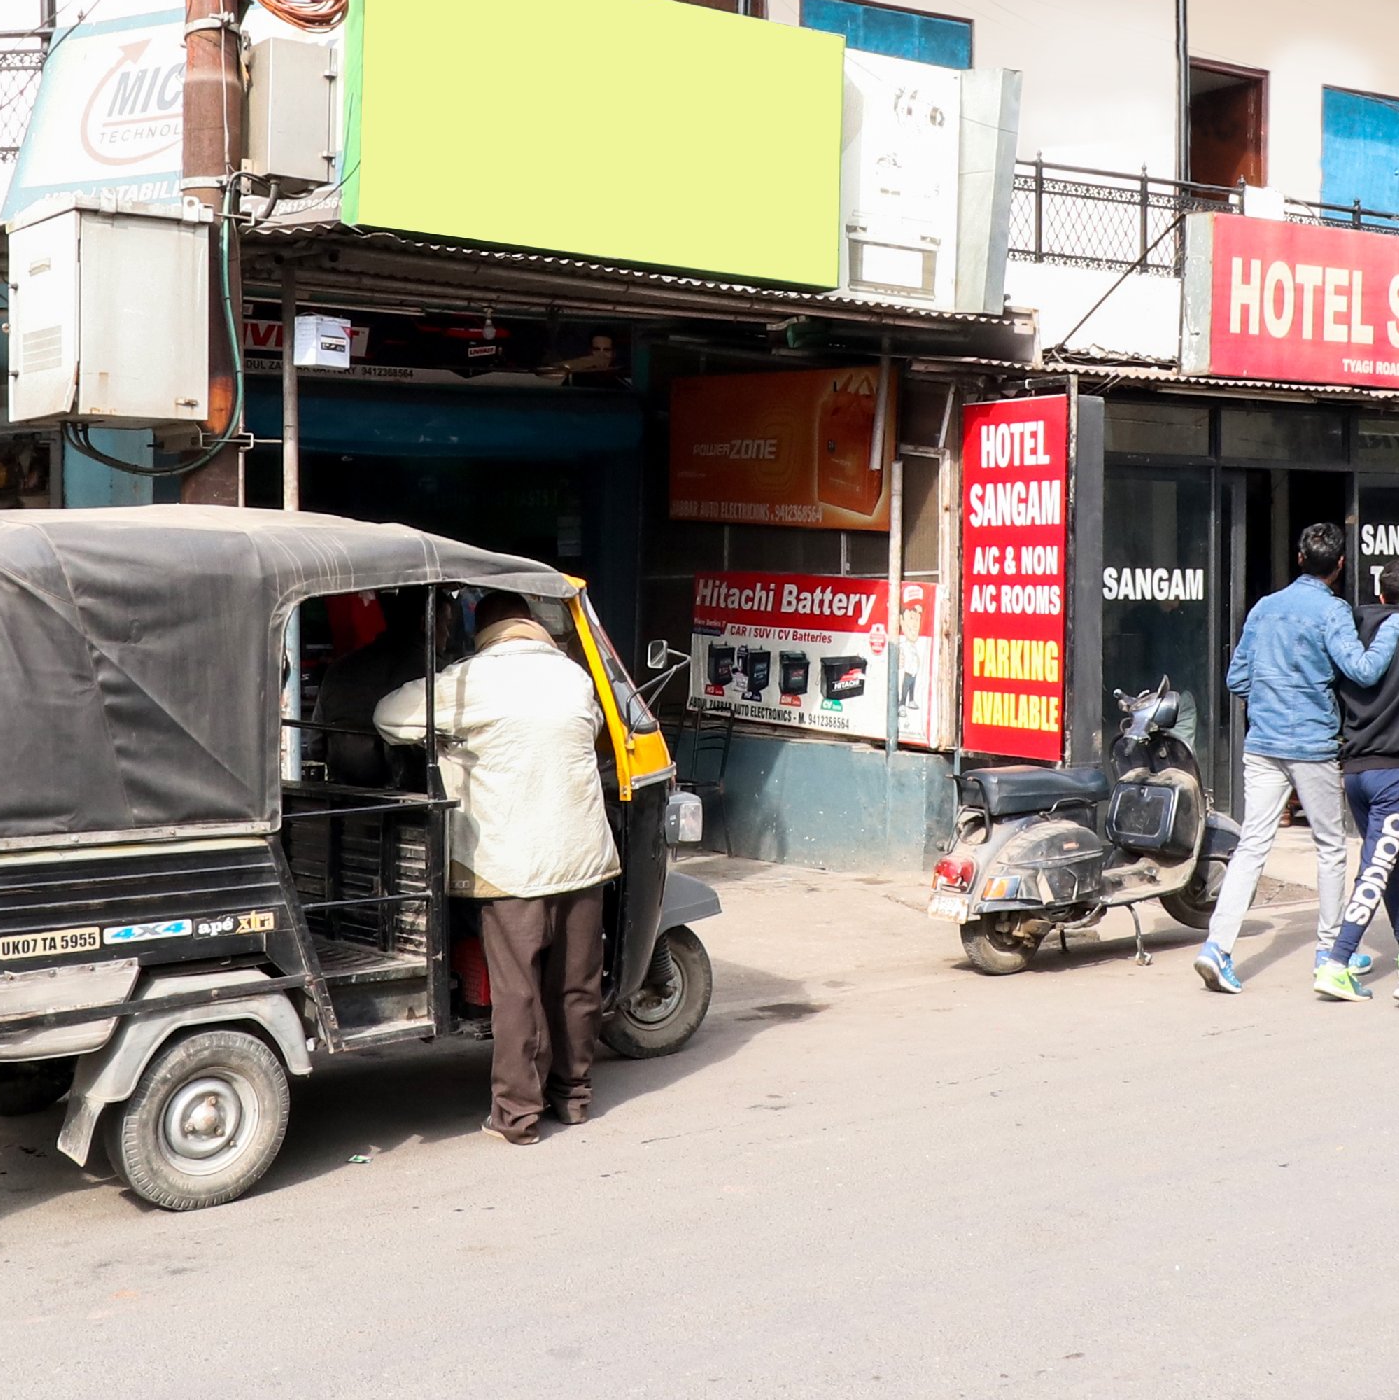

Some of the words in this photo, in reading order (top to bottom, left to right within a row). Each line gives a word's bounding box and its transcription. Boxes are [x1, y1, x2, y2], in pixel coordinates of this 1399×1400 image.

[108, 62, 184, 116] MIC
[99, 121, 183, 145] TECHNOL
[1229, 257, 1374, 345] HOTEL
[1342, 359, 1374, 375] TYAGI
[980, 420, 1050, 468] HOTEL
[969, 480, 1061, 528] SANGAM
[972, 546, 999, 575] A/C
[1005, 548, 1016, 575] &
[1021, 546, 1058, 575] NON
[970, 585, 997, 614] A/C
[1001, 585, 1061, 615] ROOMS
[1102, 567, 1204, 600] SANGAM
[696, 579, 776, 612] Hitachi
[780, 583, 877, 625] Battery
[730, 625, 747, 637] CAR
[753, 628, 771, 639] SUV
[777, 630, 791, 641] CV
[792, 631, 832, 644] Batteries
[973, 637, 1059, 683] PARKING
[734, 704, 749, 717] AUTO
[750, 705, 792, 722] ELECTRONICS
[808, 712, 850, 729] 9412368564
[971, 690, 1059, 732] AVAILABLE
[2, 937, 38, 956] UK07
[41, 936, 57, 952] TA
[60, 931, 97, 950] 5955
